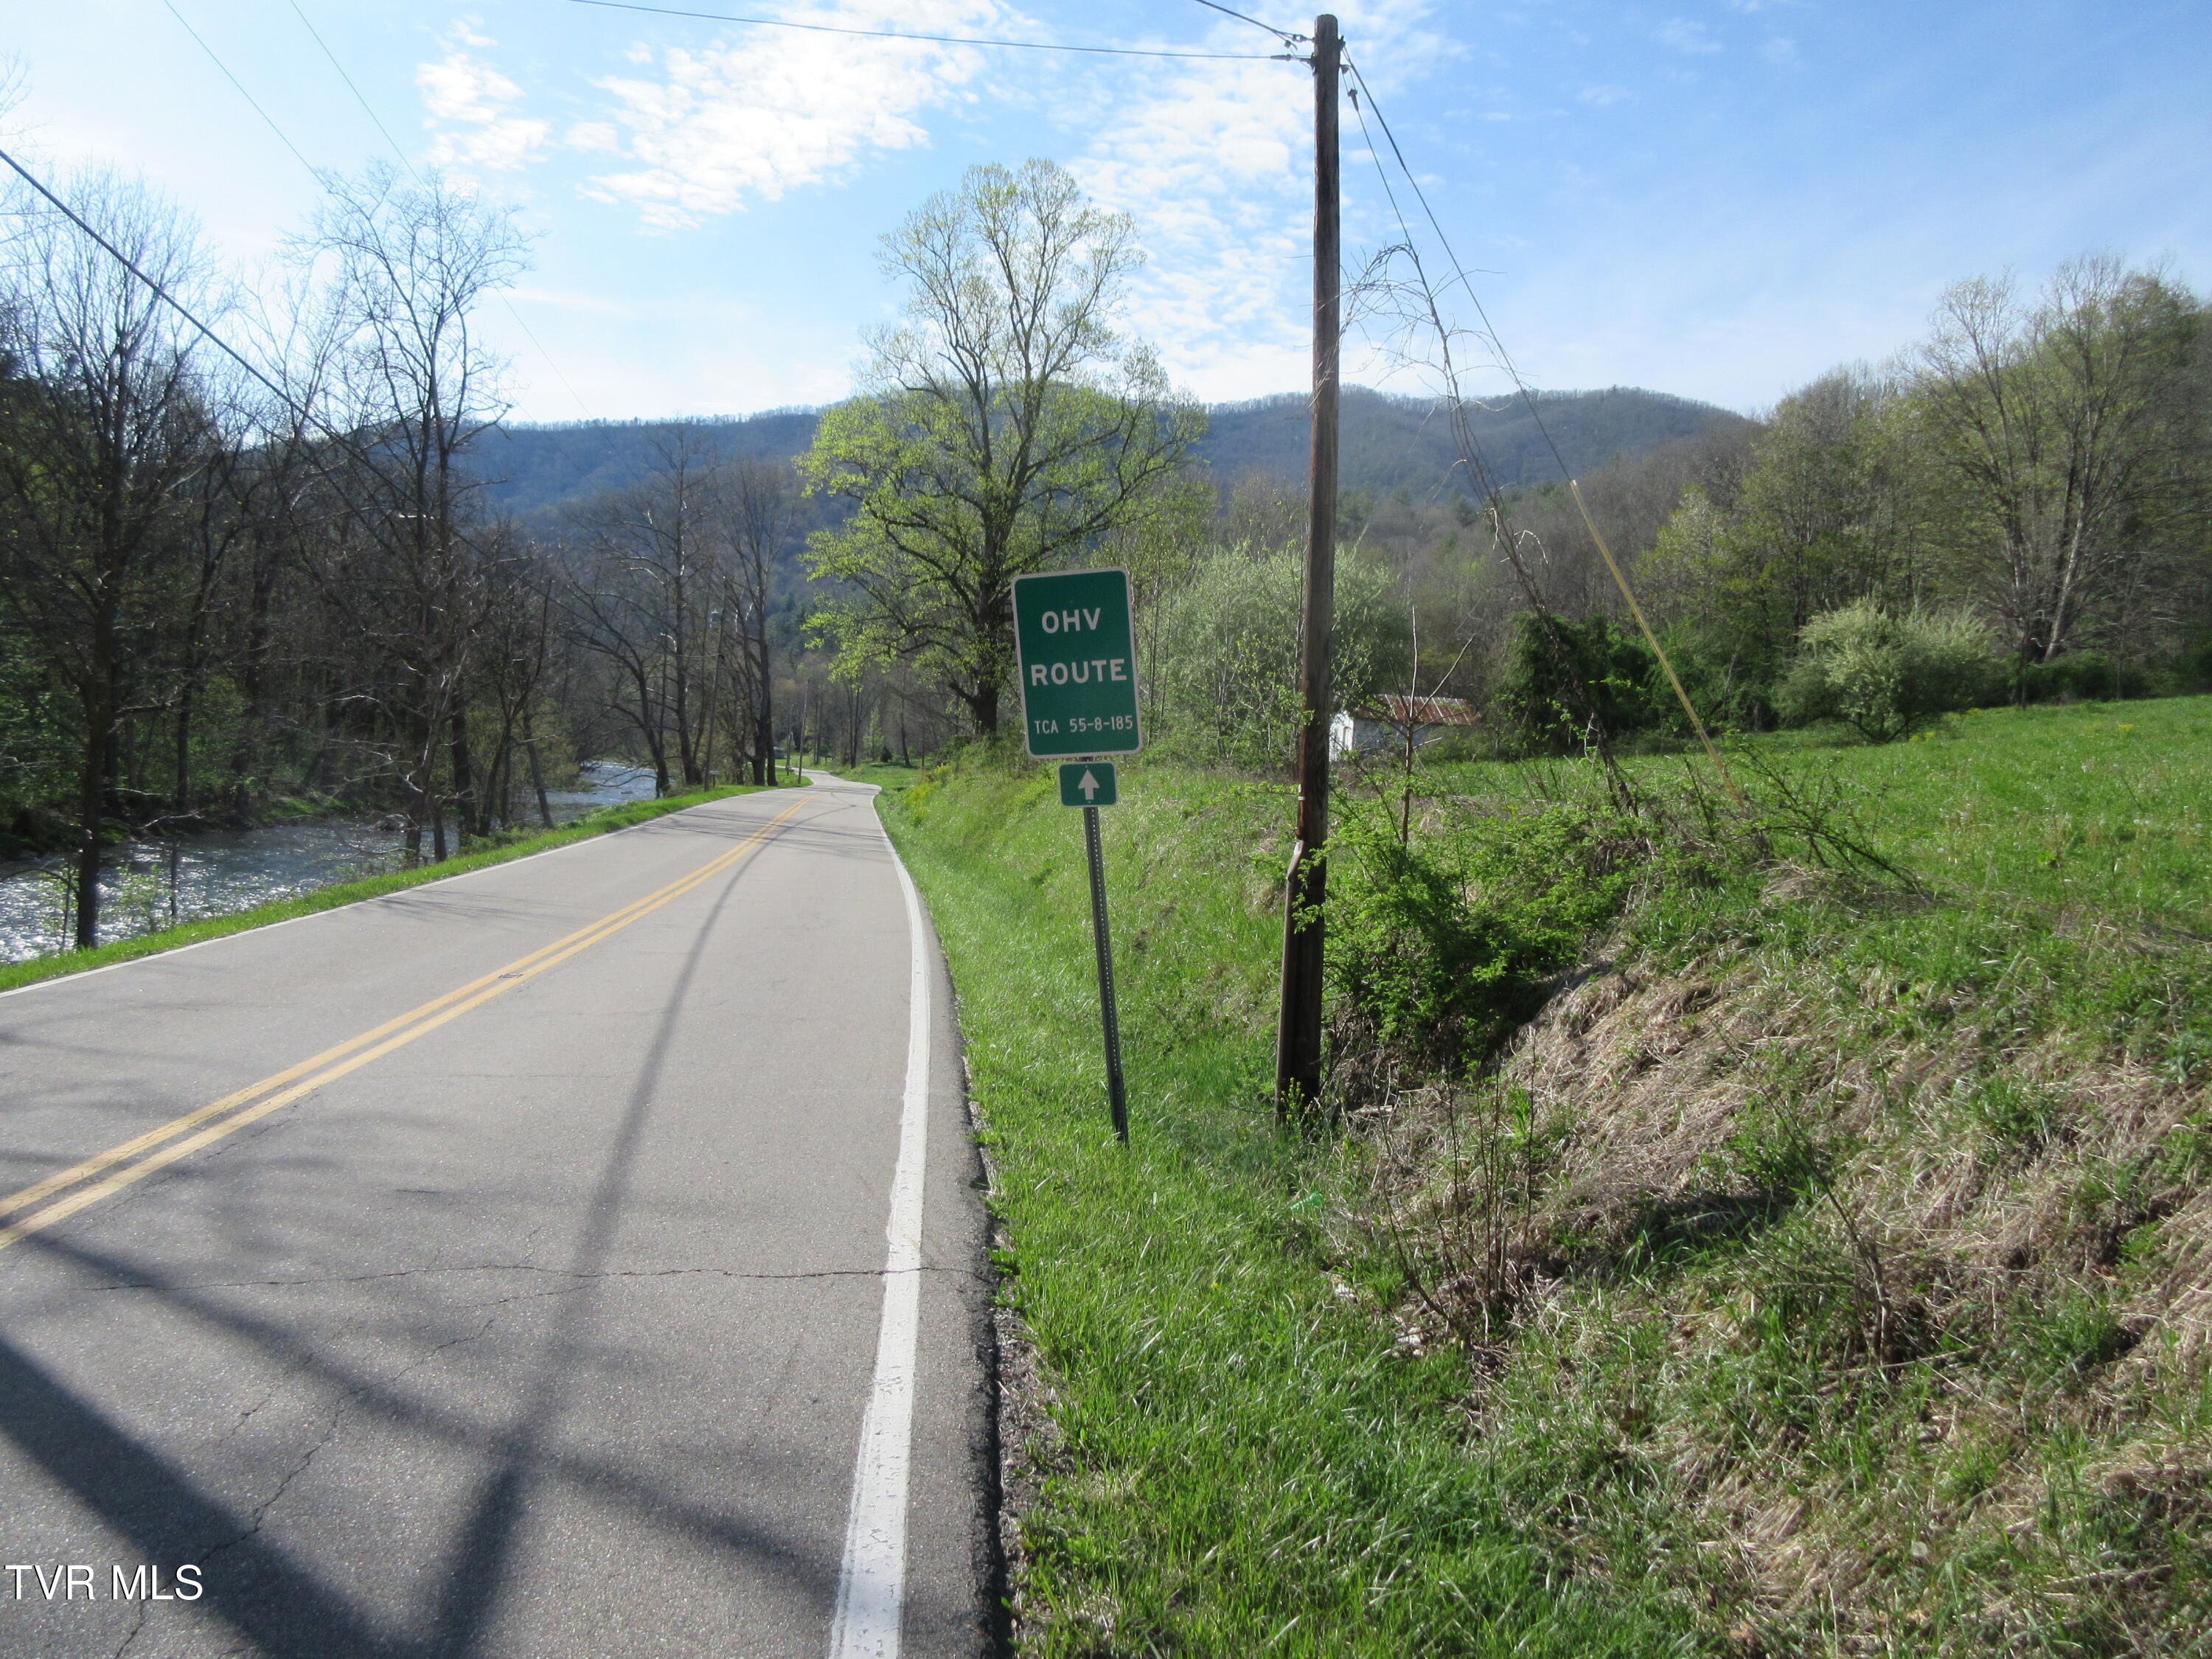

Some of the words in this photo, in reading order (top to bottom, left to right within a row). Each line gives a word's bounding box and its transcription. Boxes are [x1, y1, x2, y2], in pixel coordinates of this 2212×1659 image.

[1042, 608, 1102, 634] OHV
[1031, 658, 1127, 686] ROUTE
[1034, 720, 1059, 734] TCA
[1069, 715, 1133, 733] 55-8-185
